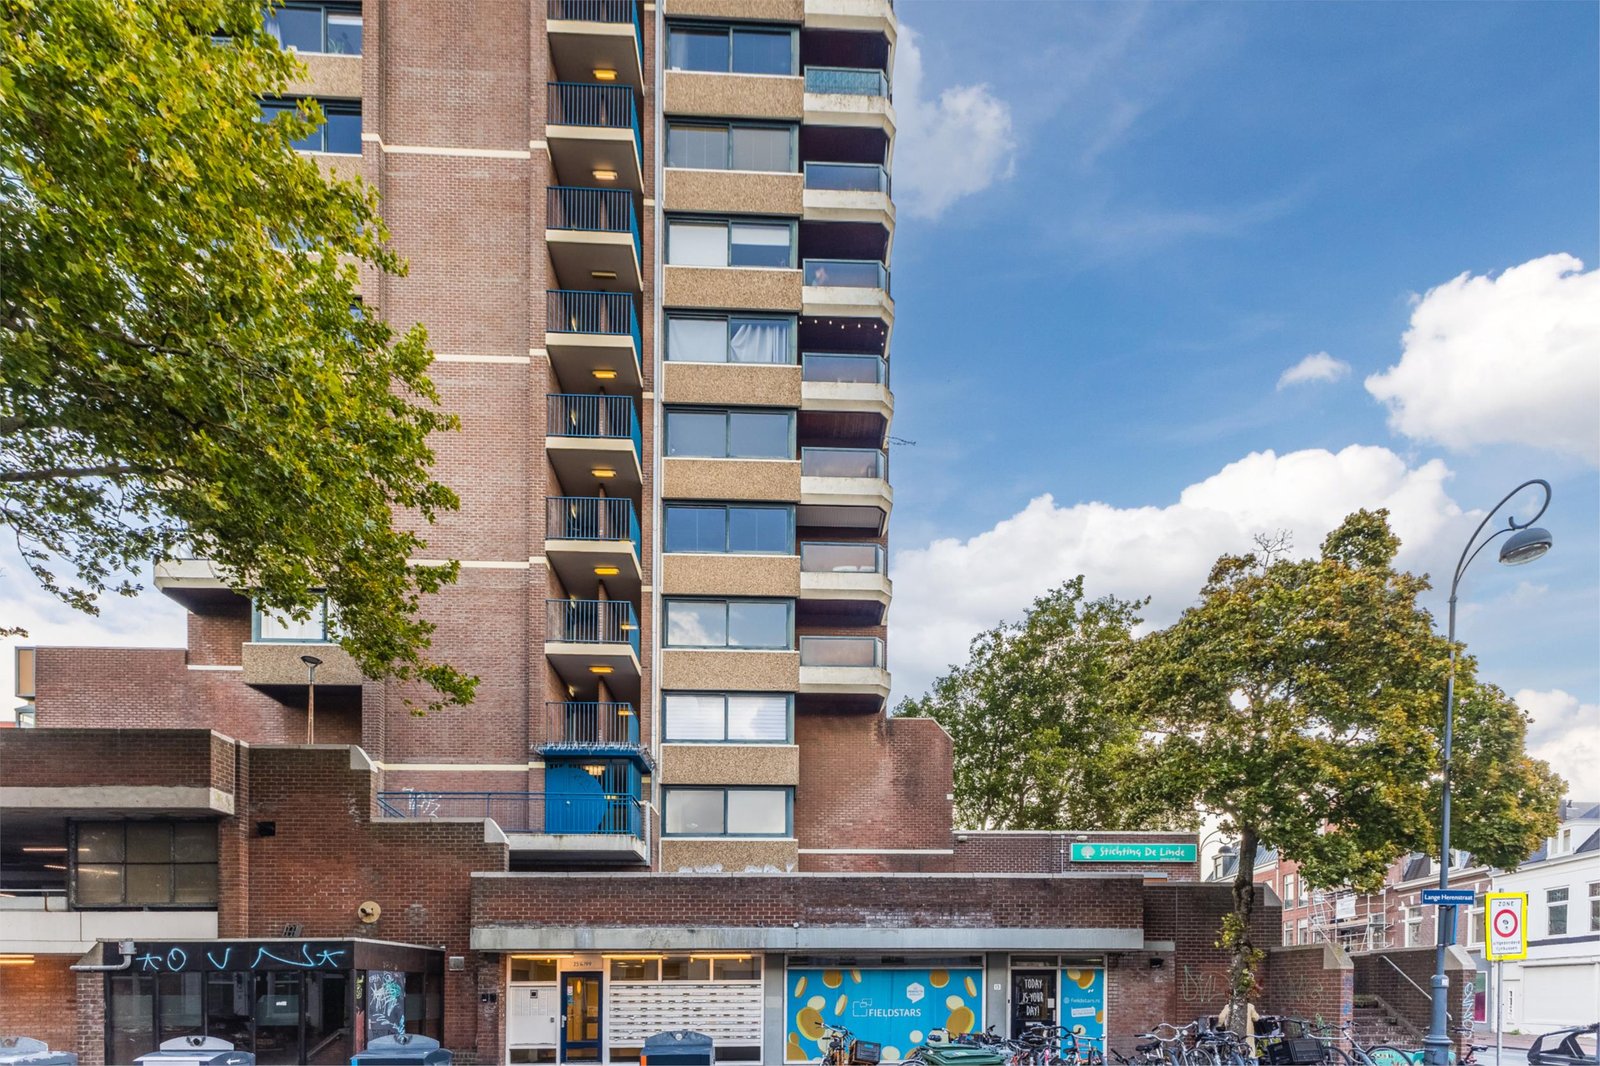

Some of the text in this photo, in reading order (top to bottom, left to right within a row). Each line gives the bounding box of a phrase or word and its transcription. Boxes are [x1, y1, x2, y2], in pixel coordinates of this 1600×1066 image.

[1100, 846, 1185, 857] Stichting De Linde
[1424, 894, 1440, 902] Lange
[1024, 978, 1043, 990] TODAY
[869, 1008, 922, 1018] FIELDSTARS
